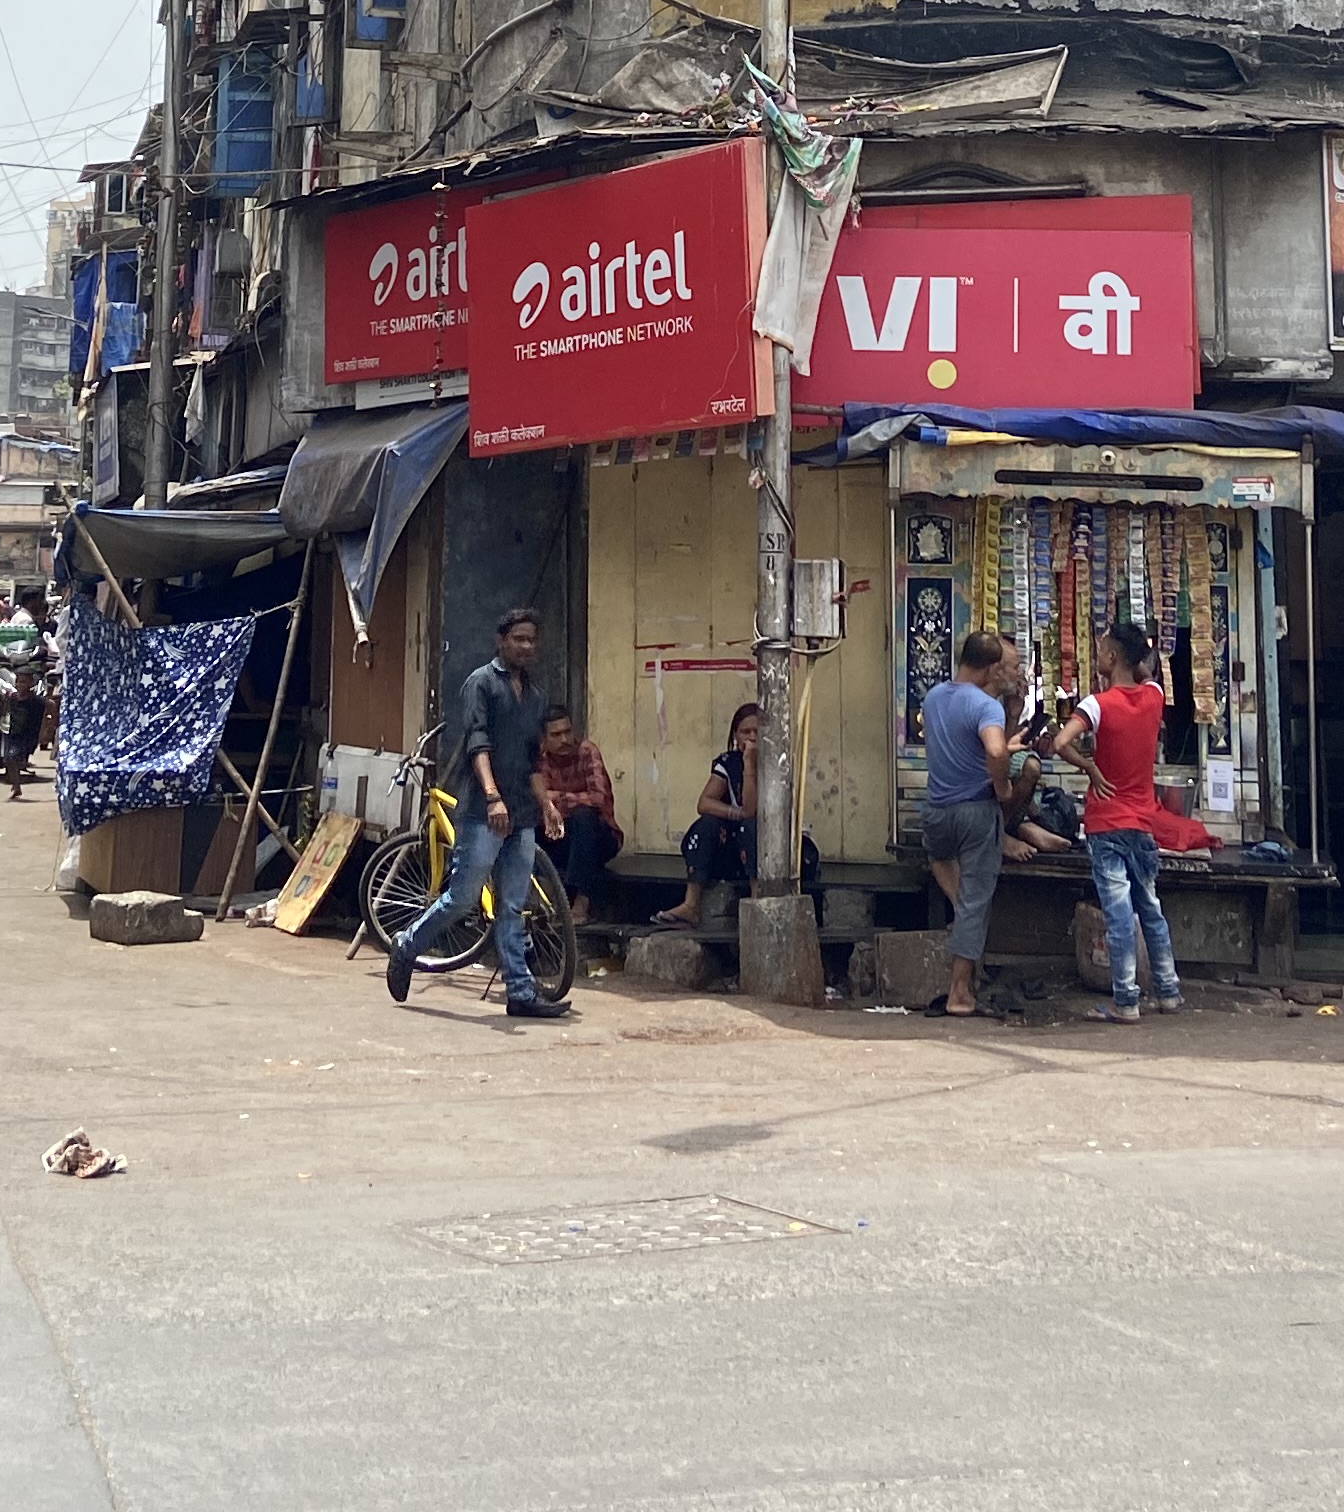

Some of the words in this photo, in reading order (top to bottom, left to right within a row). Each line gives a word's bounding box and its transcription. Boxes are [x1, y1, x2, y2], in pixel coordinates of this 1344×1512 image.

[560, 230, 692, 322] airtel
[370, 320, 388, 337] THE
[1059, 271, 1141, 356] वी
[514, 342, 537, 361] THE
[540, 327, 624, 358] SMARTPHONE
[626, 316, 694, 343] NETWORK
[474, 430, 489, 448] शिव
